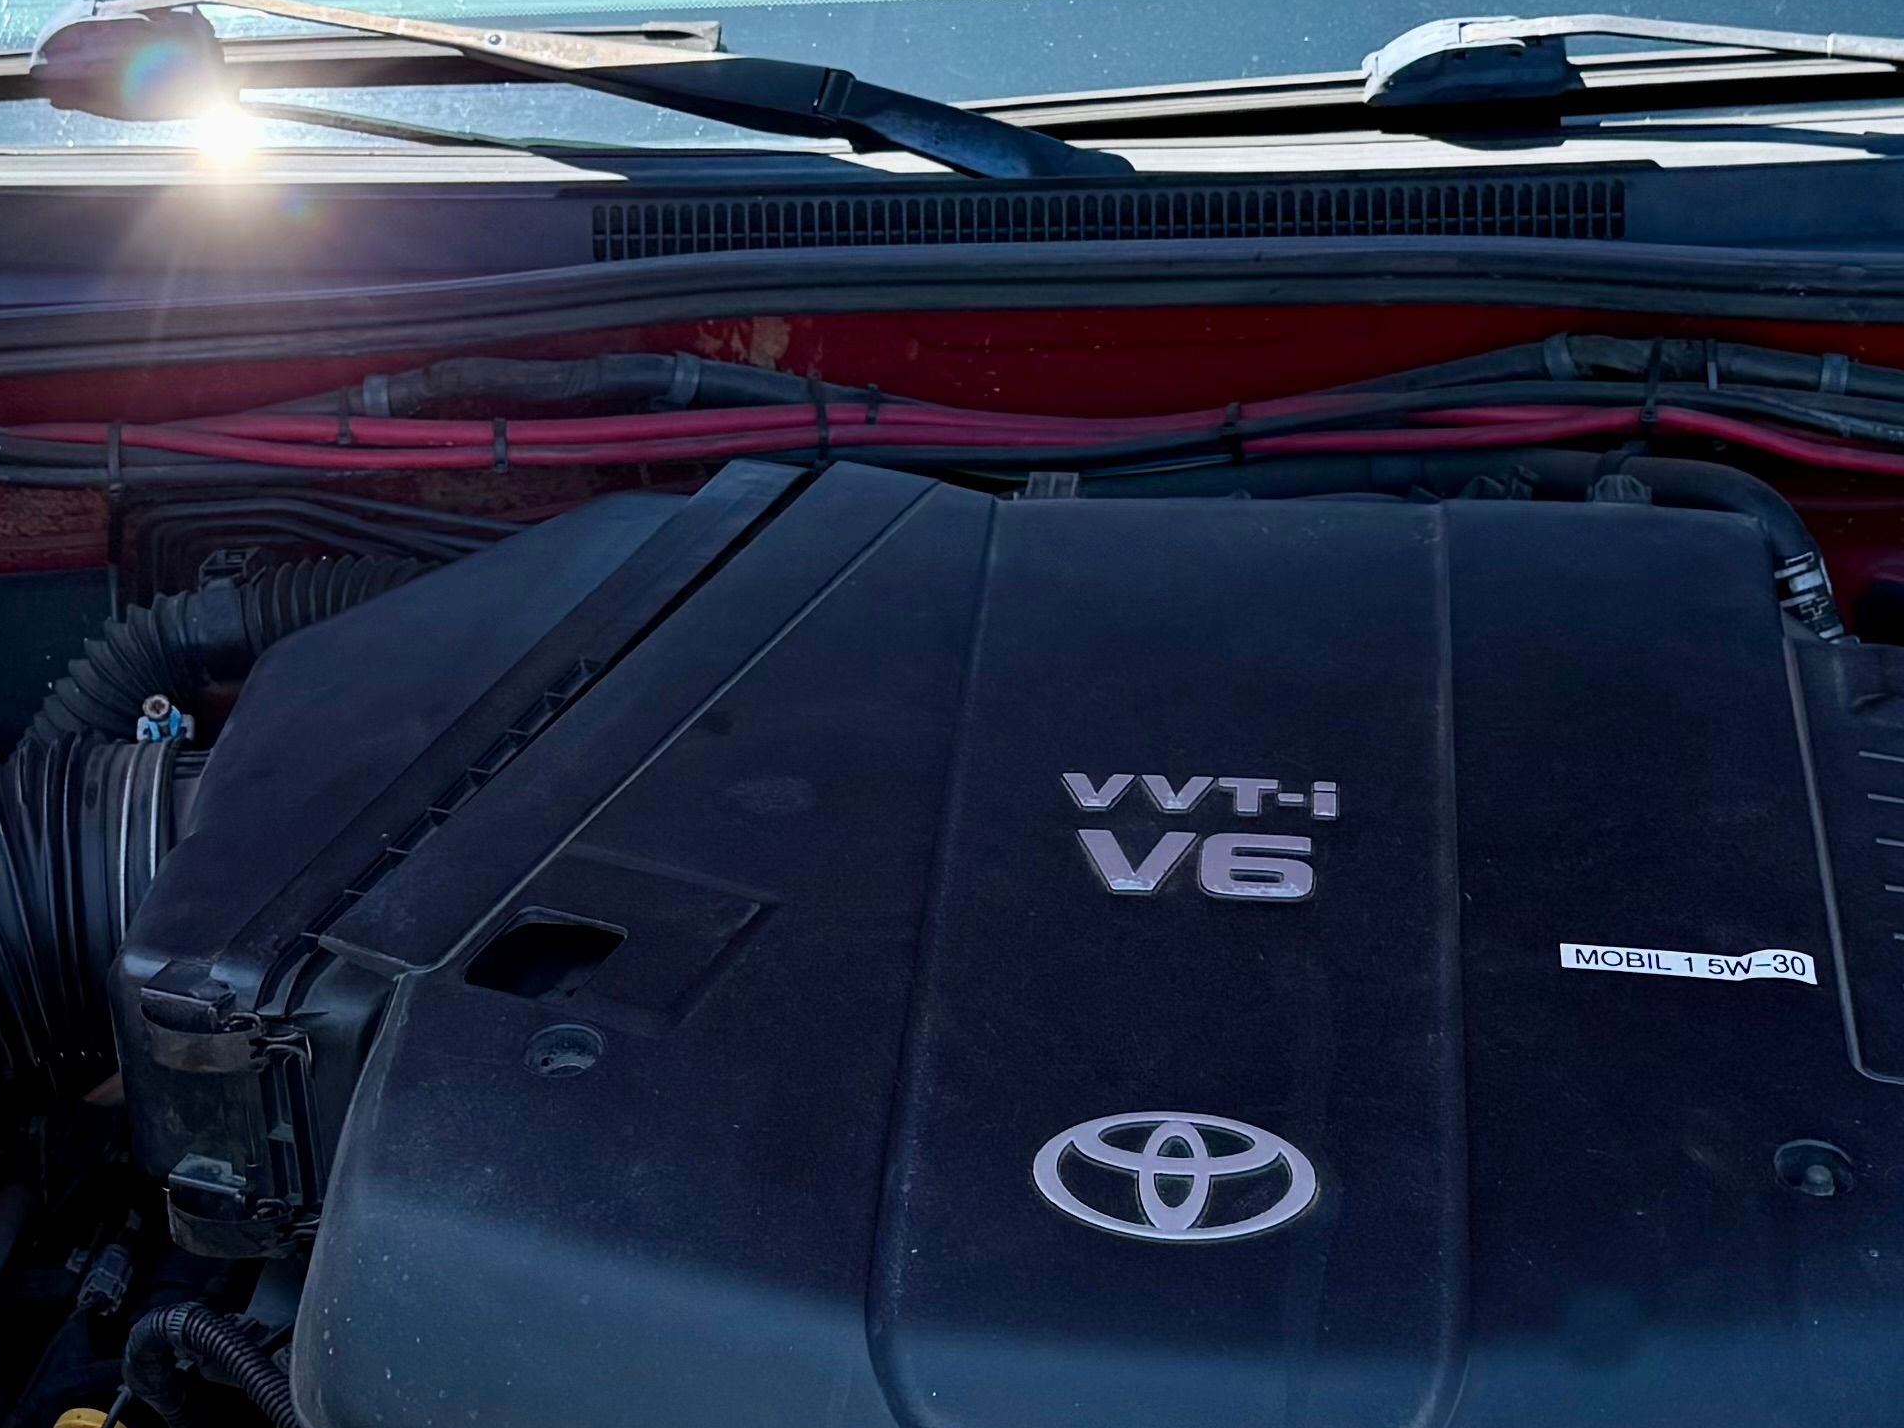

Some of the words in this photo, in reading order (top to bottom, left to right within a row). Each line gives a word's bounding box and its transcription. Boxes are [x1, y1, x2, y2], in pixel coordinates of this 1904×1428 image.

[1061, 772, 1340, 820] VVT-i
[1076, 828, 1316, 902] V6
[1574, 947, 1673, 972] MOBIL
[1683, 956, 1696, 974] 1
[1707, 952, 1809, 979] 5W-30
